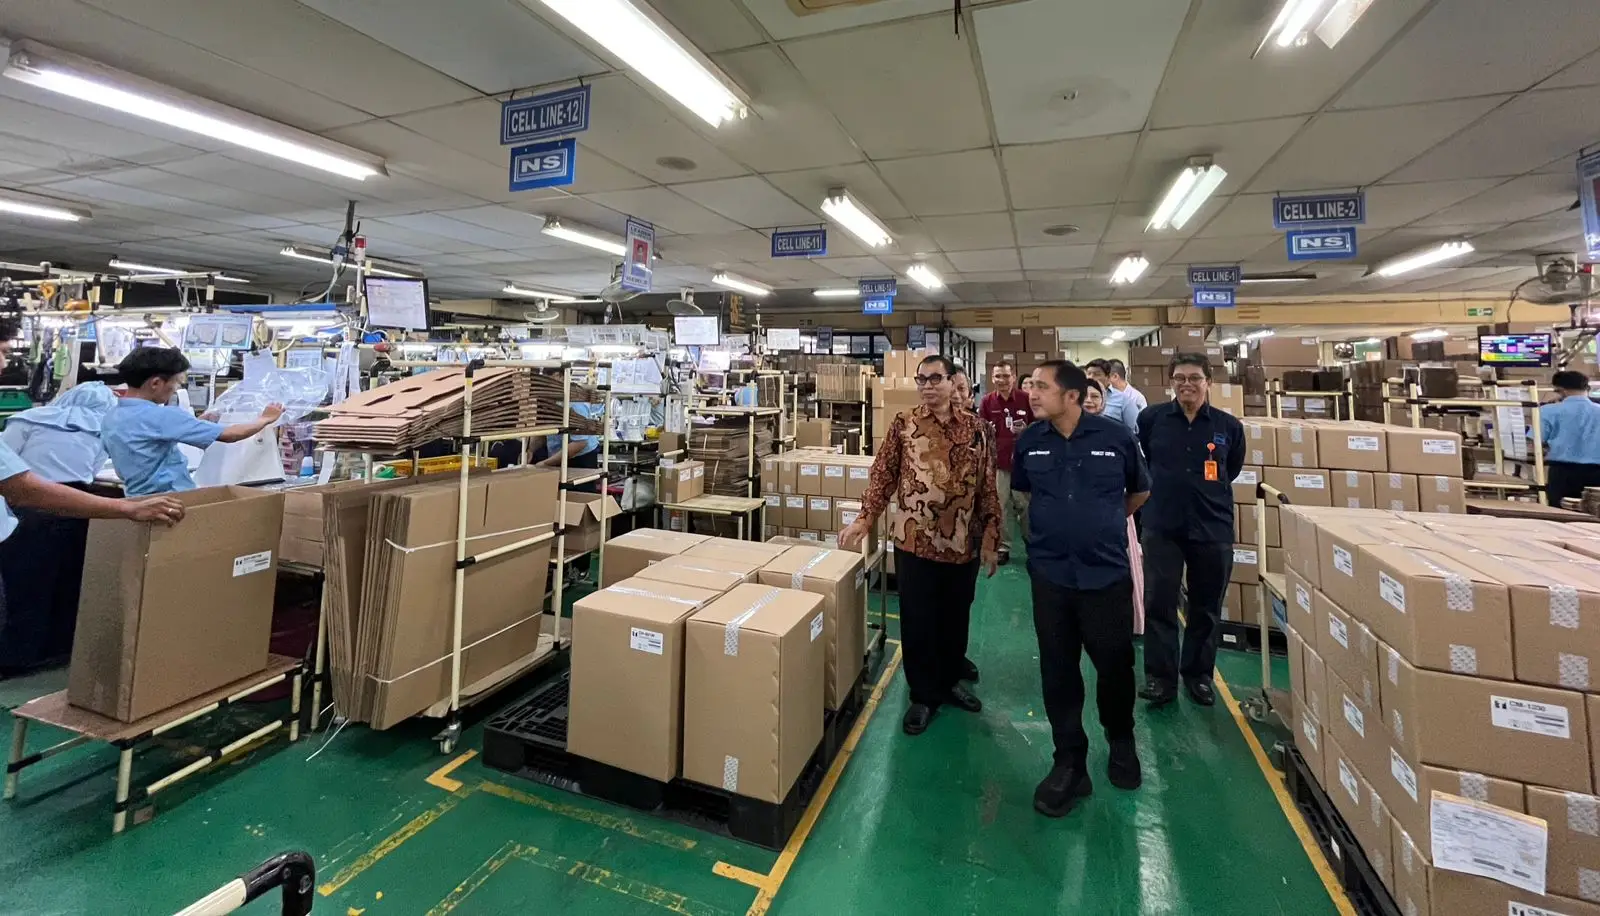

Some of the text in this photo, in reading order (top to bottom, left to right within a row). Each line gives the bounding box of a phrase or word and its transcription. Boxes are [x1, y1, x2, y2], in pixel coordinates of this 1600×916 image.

[511, 100, 579, 133] CELL LINE-12
[521, 156, 561, 173] NS
[1283, 201, 1356, 220] CELL LINE-2
[777, 236, 820, 251] CELL LINE-11
[1300, 237, 1344, 248] NS
[1192, 271, 1235, 282] CELL LINE-1
[862, 284, 874, 293] CELL
